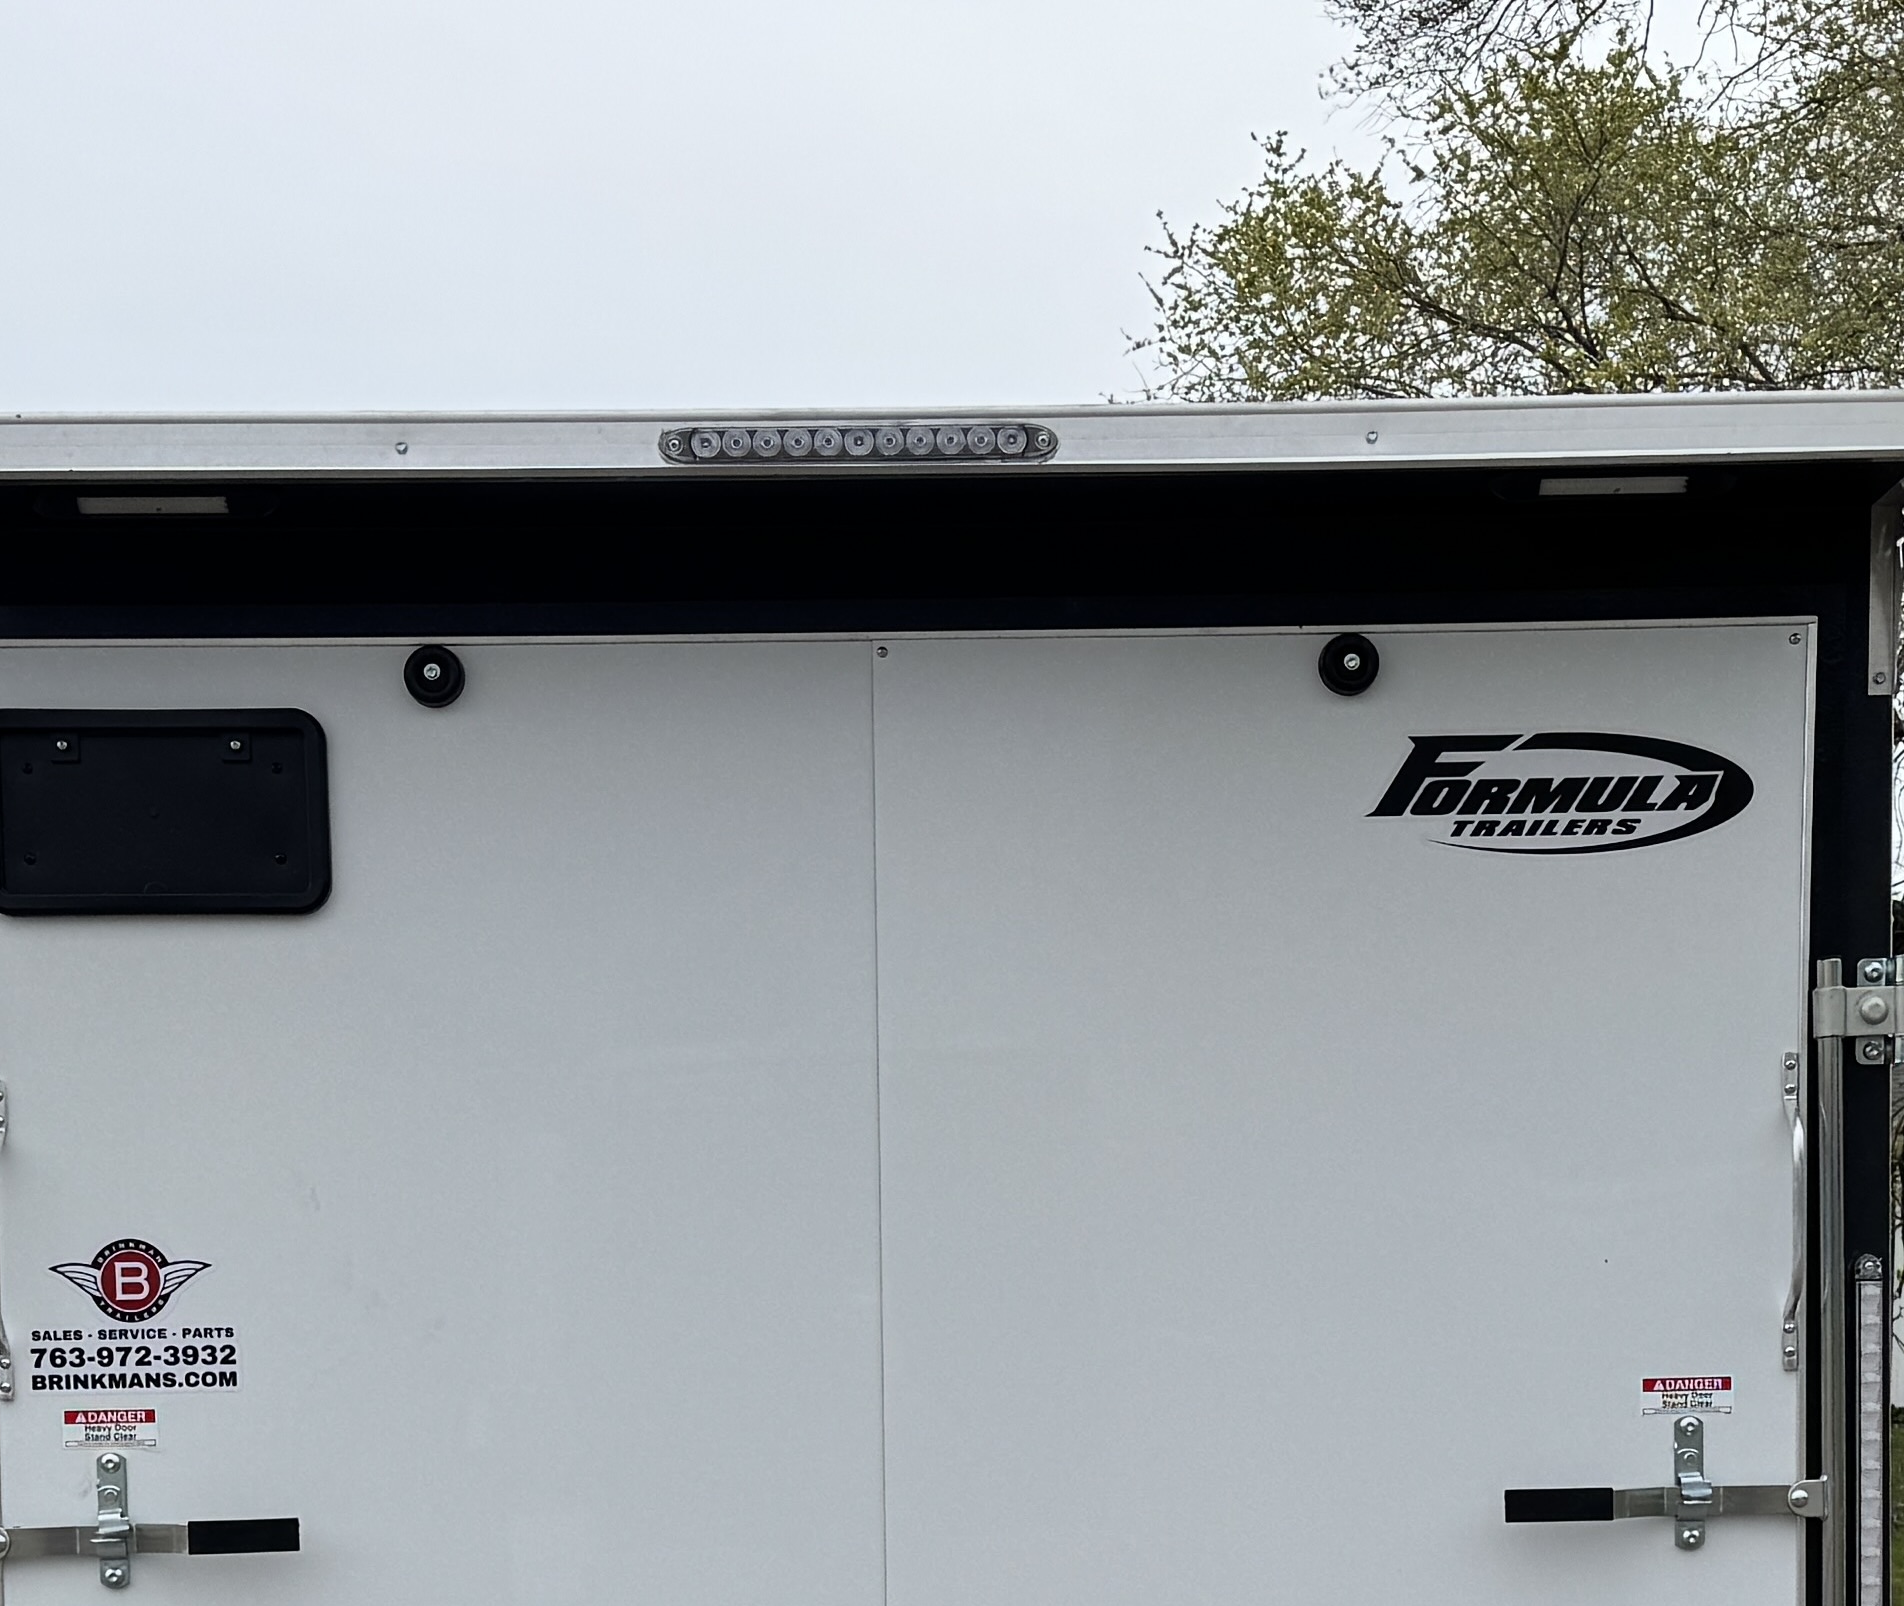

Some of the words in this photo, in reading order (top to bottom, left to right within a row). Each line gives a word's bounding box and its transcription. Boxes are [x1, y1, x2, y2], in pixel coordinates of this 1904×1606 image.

[1364, 734, 1724, 817] FORMULA
[1450, 818, 1642, 838] TRAILERS
[113, 1261, 151, 1301] B
[31, 1330, 83, 1342] SALES
[97, 1328, 167, 1340] SERVICE
[181, 1327, 234, 1339] PARTS
[30, 1345, 237, 1369] 763-972-3932
[31, 1371, 238, 1391] BRINKMANS.COM
[1666, 1378, 1722, 1390] DANGER
[88, 1410, 146, 1423] DANGER
[84, 1424, 112, 1434] Heavy
[114, 1423, 137, 1432] Door
[84, 1432, 111, 1441] Stand
[113, 1432, 137, 1441] Clear
